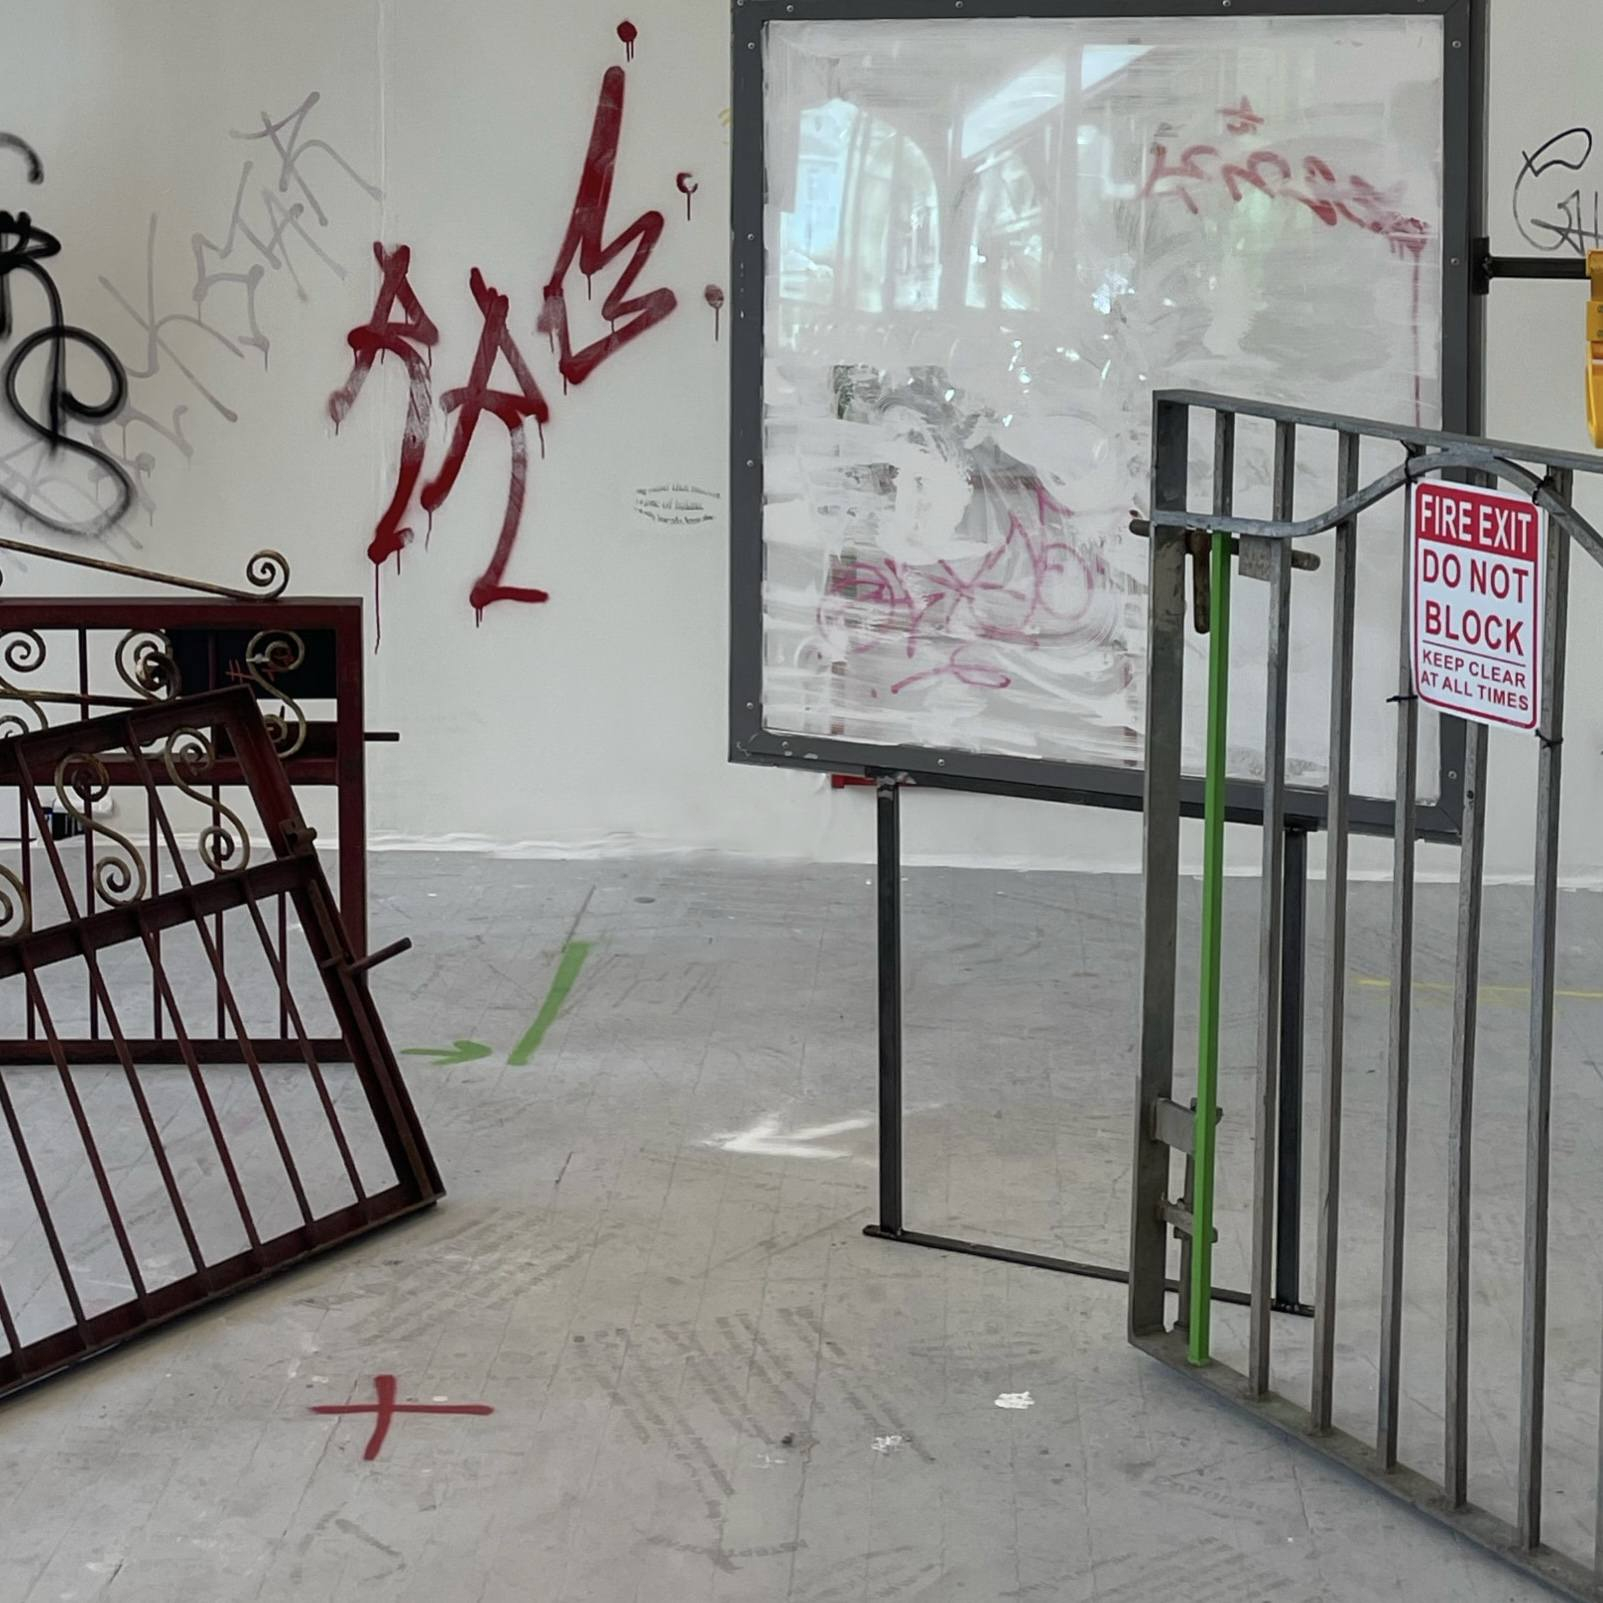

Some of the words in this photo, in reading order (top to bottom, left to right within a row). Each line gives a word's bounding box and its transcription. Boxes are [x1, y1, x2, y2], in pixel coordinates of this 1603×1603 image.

[1421, 494, 1473, 542] FIRE
[1479, 505, 1532, 554] EXIT
[1423, 549, 1461, 588] DO
[1470, 559, 1529, 603] NOT
[1425, 600, 1524, 656] BLOCK
[1421, 671, 1439, 688] AT
[1442, 676, 1473, 697] ALL
[1478, 685, 1529, 711] TIMES
[1423, 649, 1464, 673] KEEP
[1469, 662, 1526, 688] CLEAR
